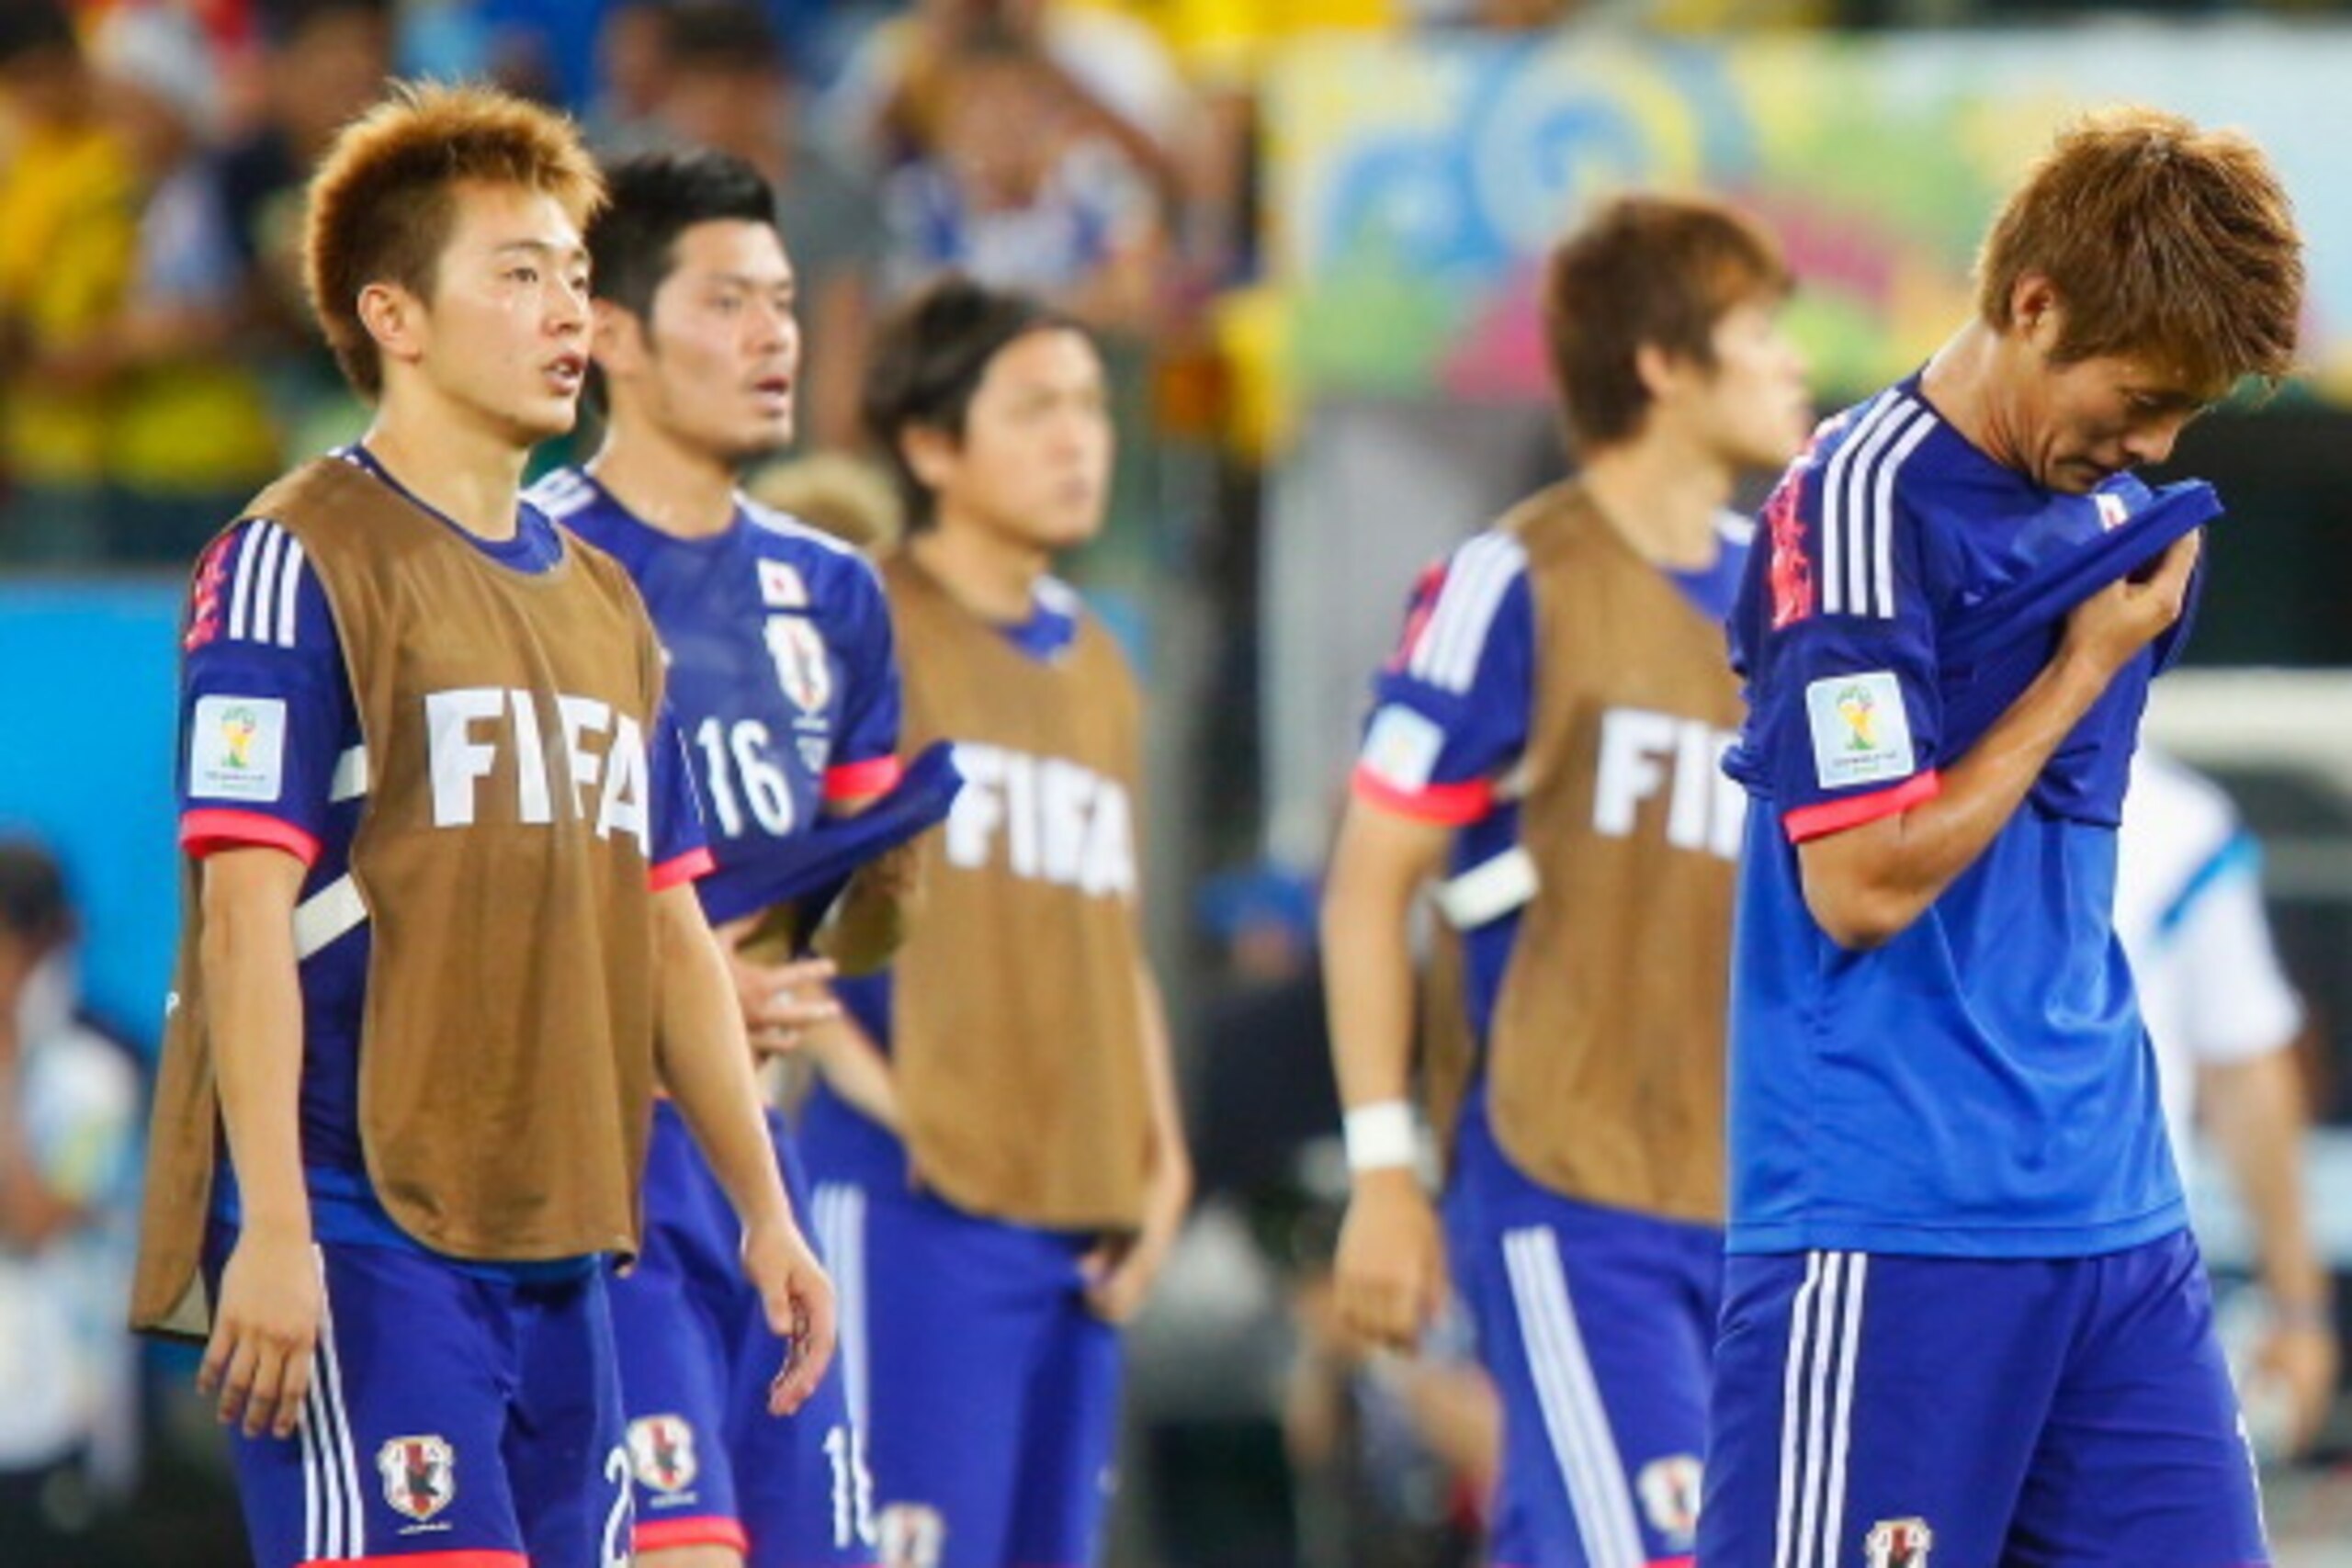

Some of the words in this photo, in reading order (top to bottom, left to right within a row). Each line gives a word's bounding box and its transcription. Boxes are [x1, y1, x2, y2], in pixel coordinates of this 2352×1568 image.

[424, 687, 651, 858] FIFA
[697, 716, 795, 836] 16
[945, 741, 1137, 898] FIFA
